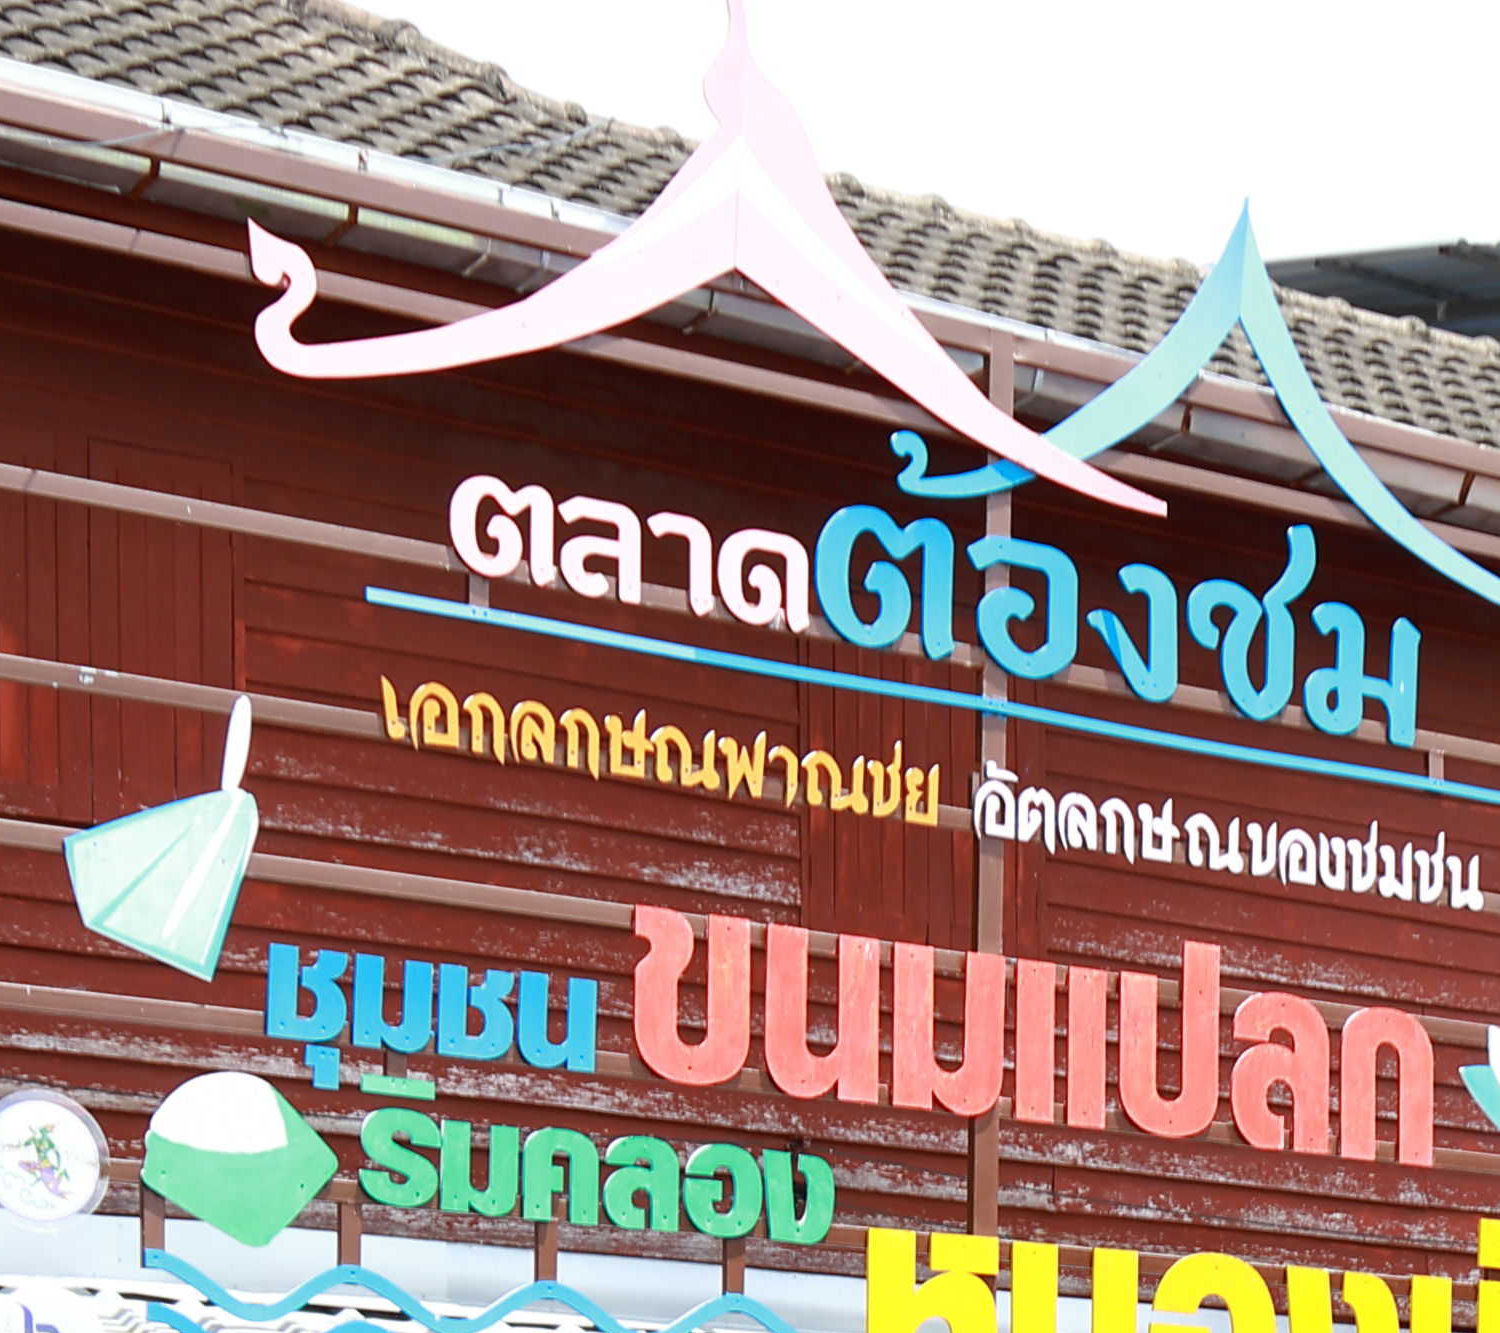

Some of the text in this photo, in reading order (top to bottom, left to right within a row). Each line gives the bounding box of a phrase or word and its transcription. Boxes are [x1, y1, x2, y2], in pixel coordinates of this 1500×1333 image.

[265, 903, 1435, 1167] ชุมชน ขนมแปลก
[357, 1072, 837, 1246] ริมคลอง
